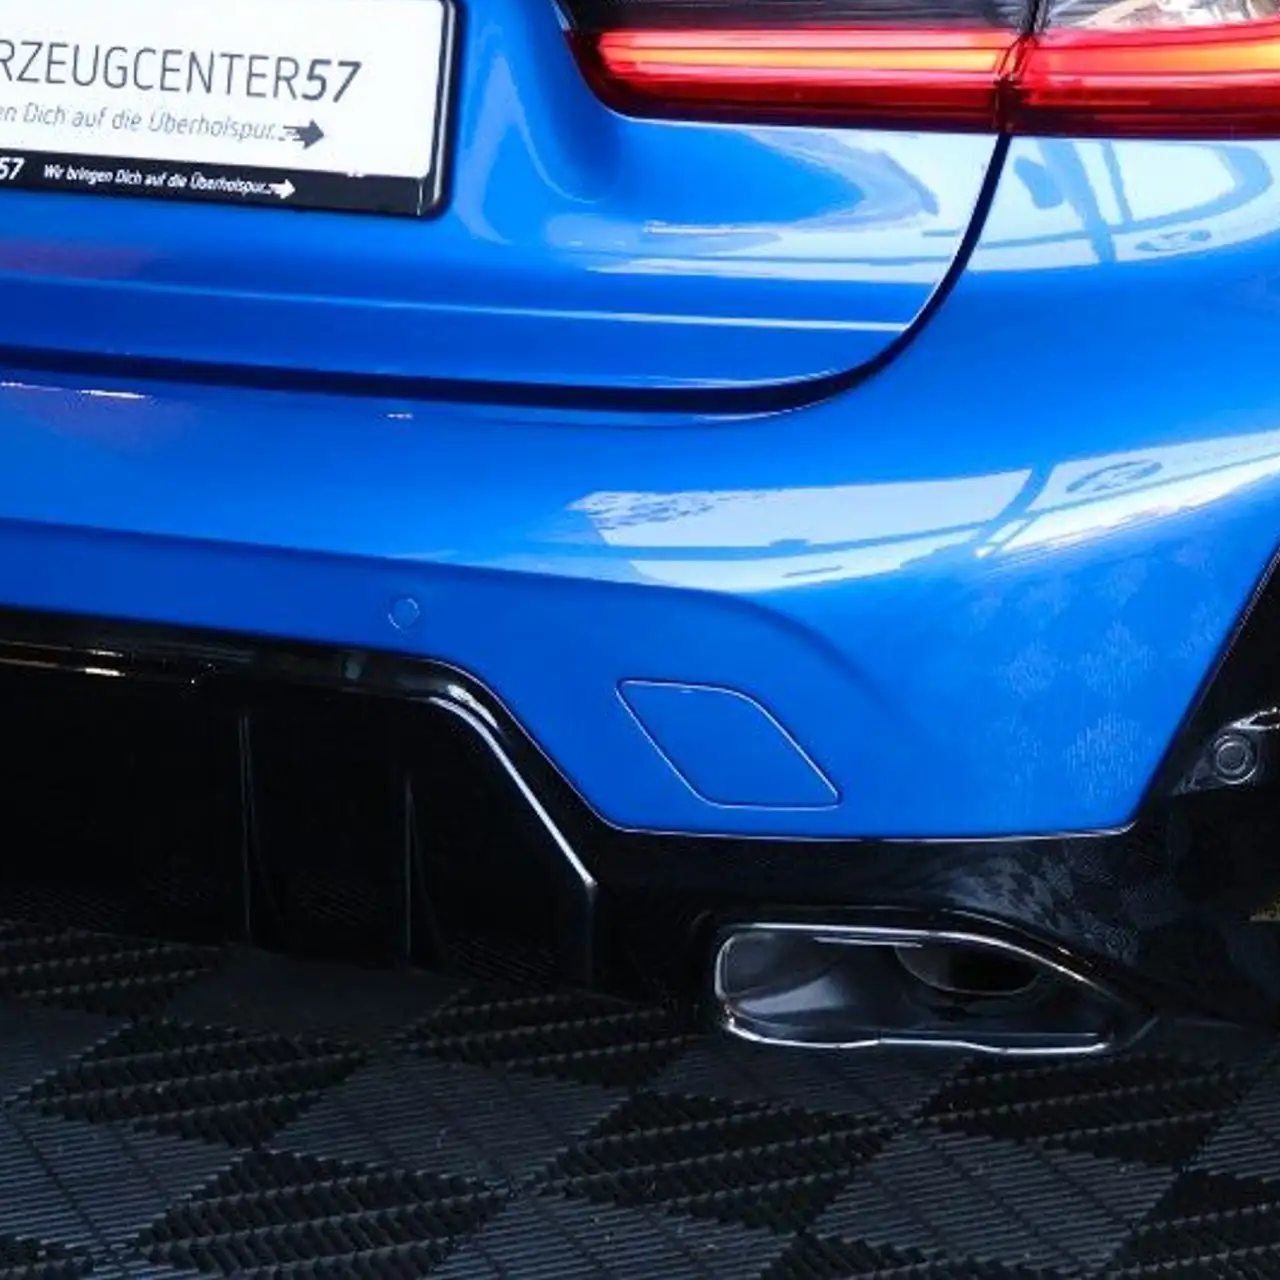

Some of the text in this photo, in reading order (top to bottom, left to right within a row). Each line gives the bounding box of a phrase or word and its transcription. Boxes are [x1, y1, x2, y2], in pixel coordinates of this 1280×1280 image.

[22, 101, 67, 126] Dich
[71, 107, 108, 129] auf
[111, 108, 142, 131] die
[43, 163, 65, 180] Wir
[66, 165, 113, 186] bringen
[114, 169, 142, 186] Dich
[145, 172, 168, 188] auf
[168, 174, 189, 189] die
